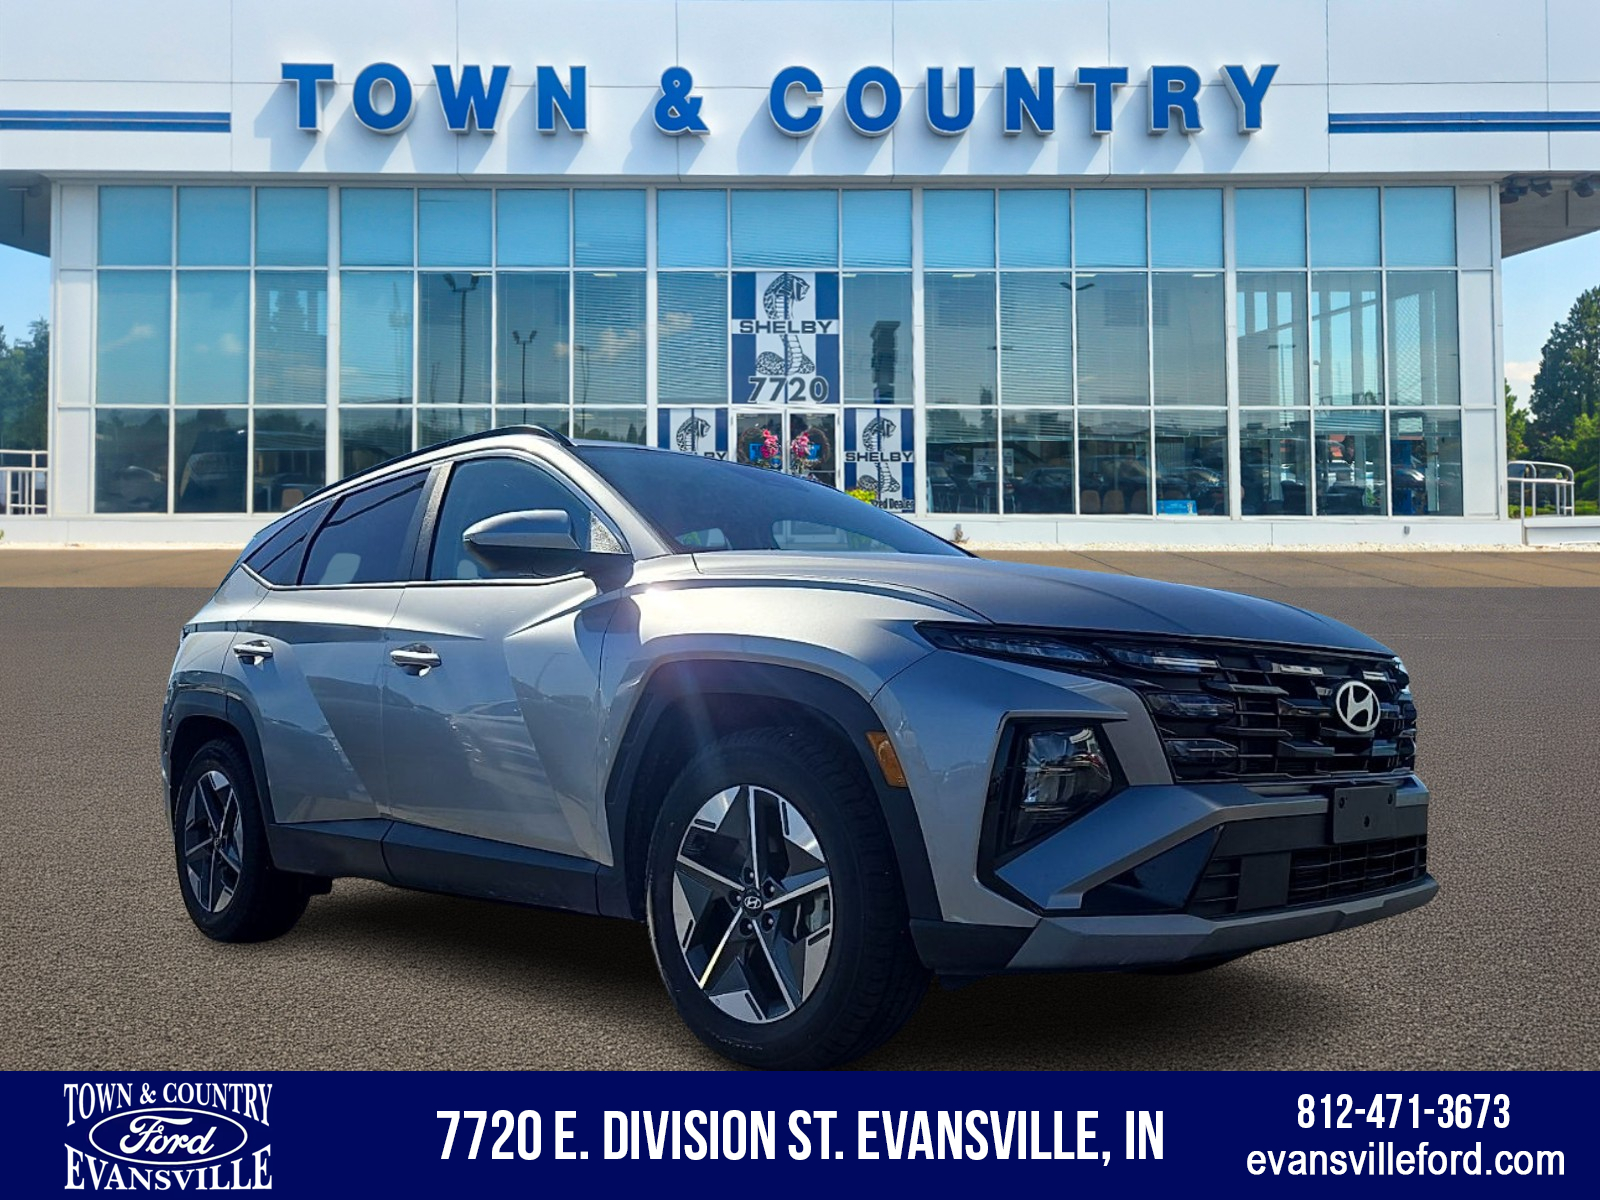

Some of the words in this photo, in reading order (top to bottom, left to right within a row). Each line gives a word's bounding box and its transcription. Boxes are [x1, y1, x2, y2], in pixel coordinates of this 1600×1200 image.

[281, 62, 589, 134] TOWN
[654, 66, 709, 135] &
[768, 64, 1279, 137] COUNTRY
[739, 320, 833, 334] SHELBY
[749, 377, 829, 402] 7720
[845, 452, 913, 462] SHELBY
